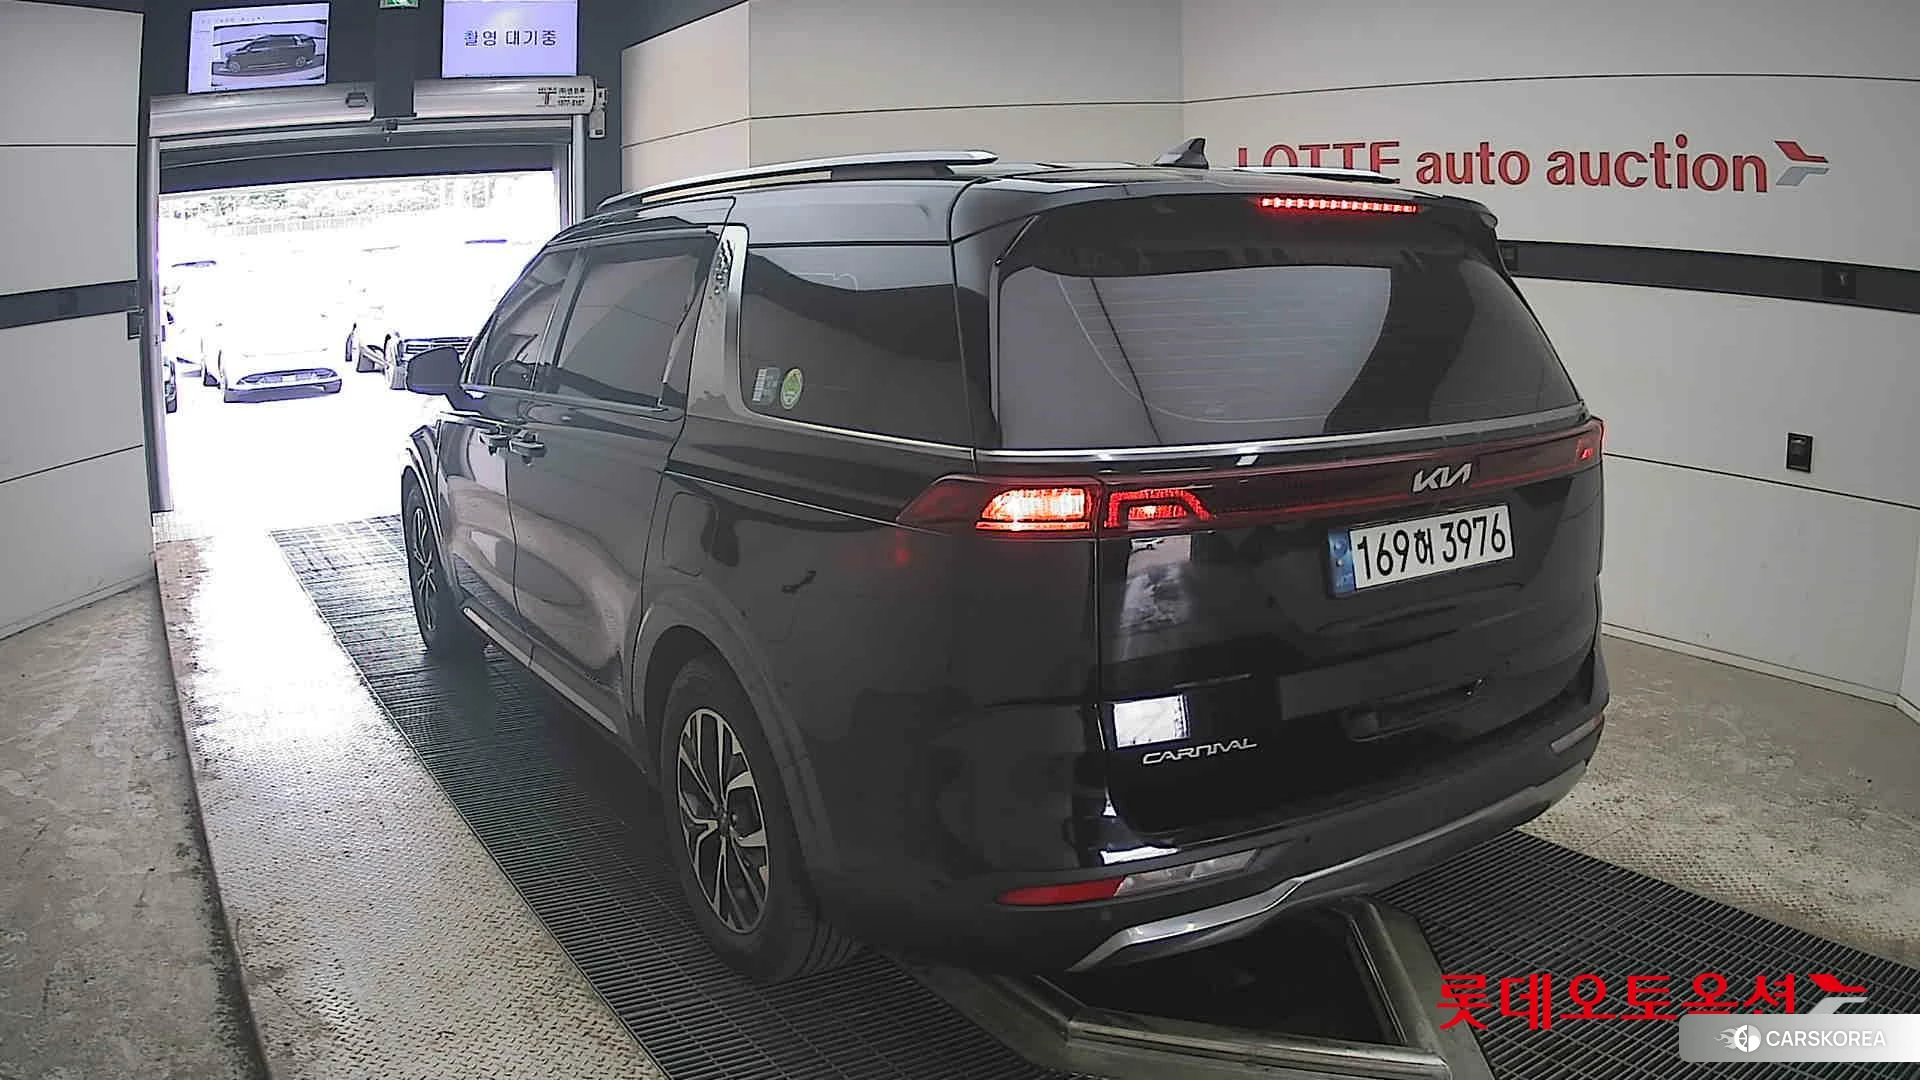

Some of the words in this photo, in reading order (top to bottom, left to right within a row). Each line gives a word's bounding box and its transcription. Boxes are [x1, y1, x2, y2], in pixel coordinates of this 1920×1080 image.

[505, 30, 557, 46] 대기중
[1416, 142, 1531, 185] auto
[1547, 134, 1768, 193] auction
[1412, 463, 1472, 493] KIA
[1440, 512, 1506, 563] 3976
[1142, 738, 1257, 765] CARNIVAL
